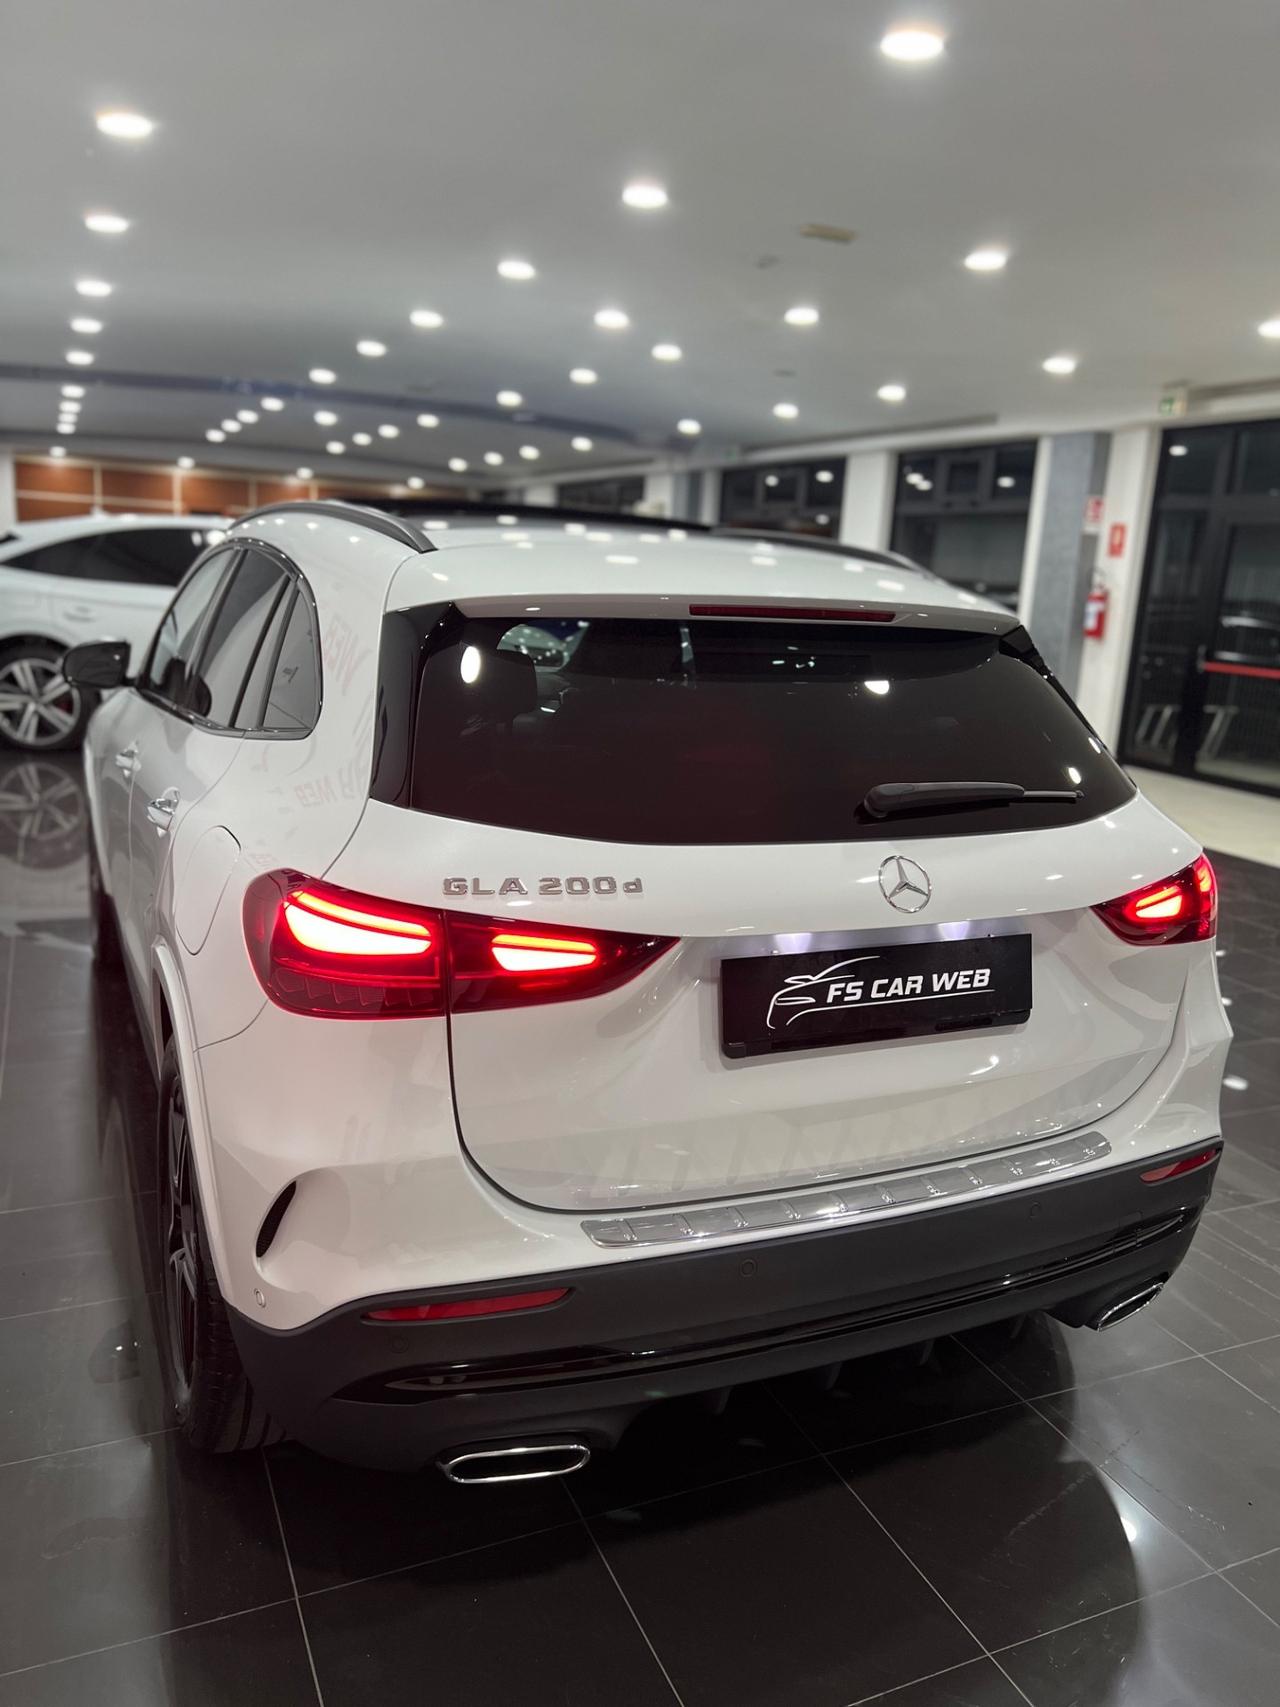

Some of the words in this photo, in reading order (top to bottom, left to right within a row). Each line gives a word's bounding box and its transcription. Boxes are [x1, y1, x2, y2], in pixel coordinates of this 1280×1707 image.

[442, 876, 529, 896] GLA
[826, 981, 864, 1004] FS
[870, 974, 922, 999] CAR
[931, 968, 991, 992] WEB
